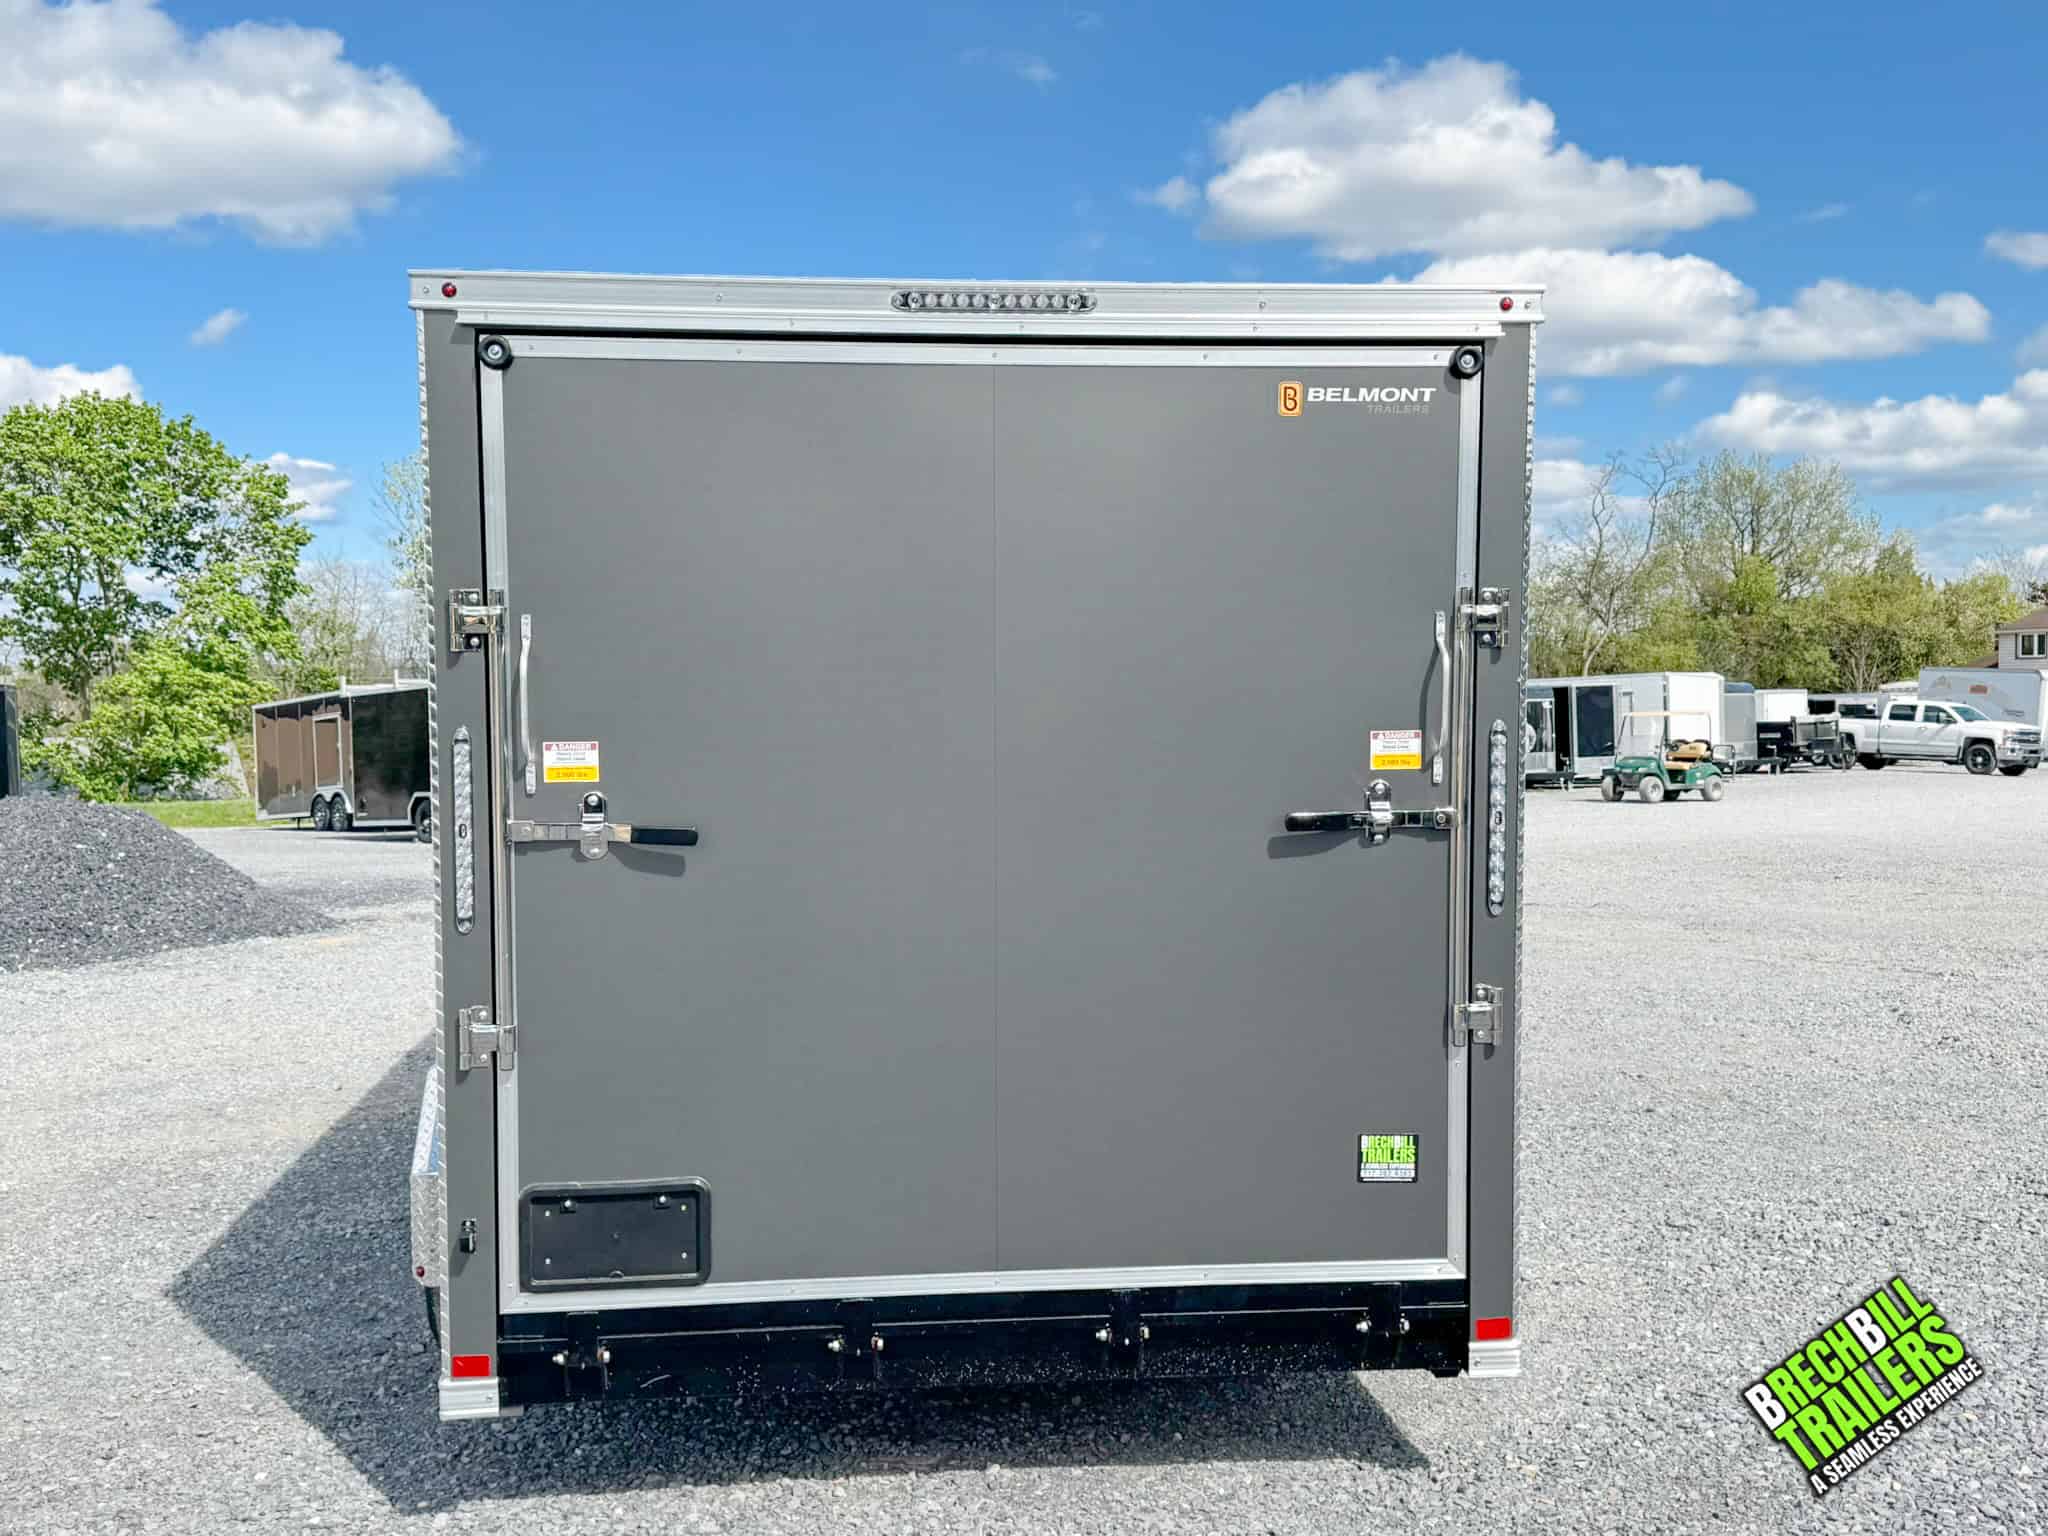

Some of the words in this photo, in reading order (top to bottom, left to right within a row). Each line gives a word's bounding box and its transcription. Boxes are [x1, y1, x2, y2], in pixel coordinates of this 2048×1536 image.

[1307, 387, 1437, 402] BELMONT
[1367, 404, 1430, 415] TRAILERS
[1361, 1148, 1416, 1162] TRAILERS
